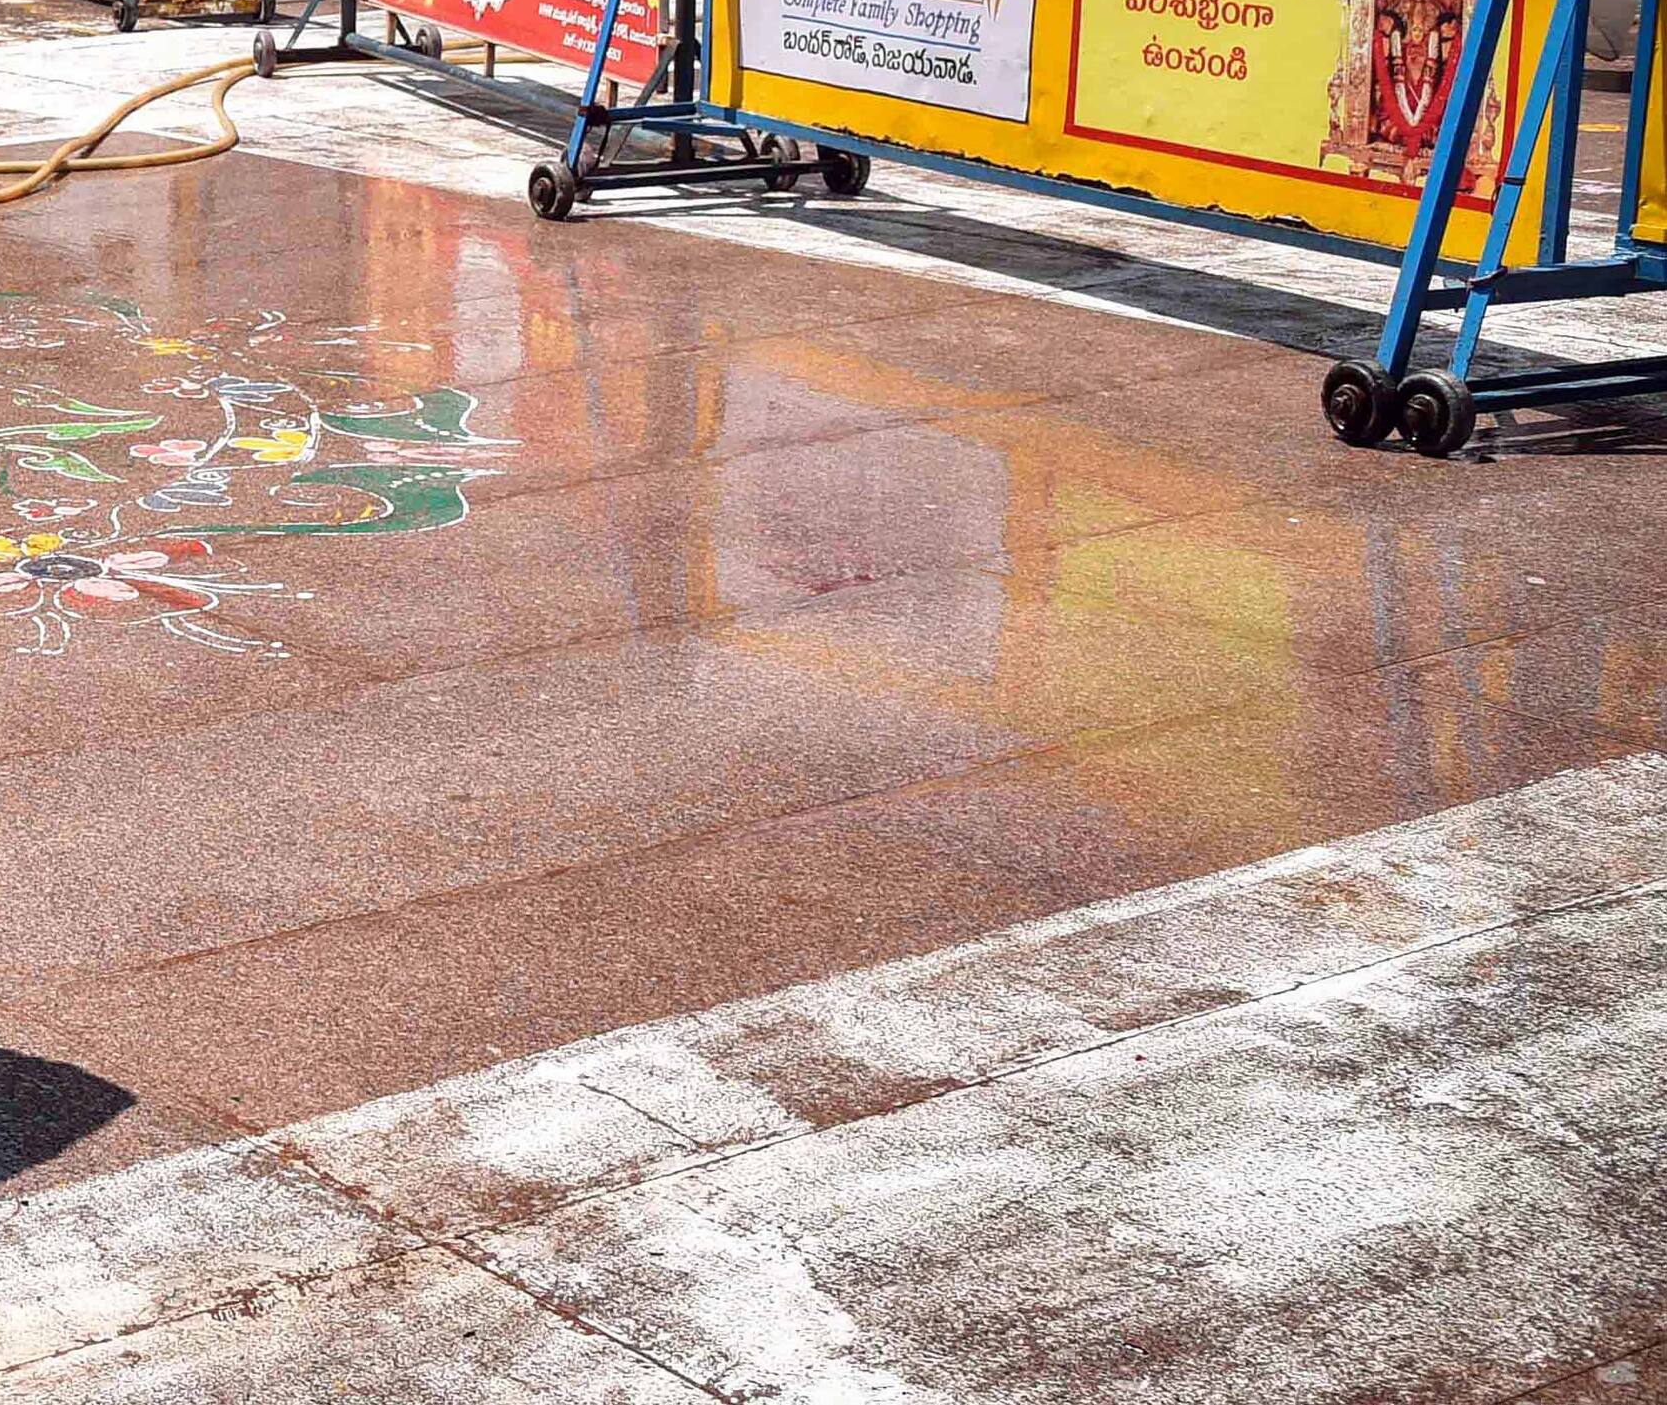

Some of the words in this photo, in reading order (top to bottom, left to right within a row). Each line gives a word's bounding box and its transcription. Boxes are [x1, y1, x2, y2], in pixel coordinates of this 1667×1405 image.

[783, 27, 834, 57] బందర్
[903, 1, 982, 45] Shopping
[1142, 34, 1248, 81] ఉంచండి
